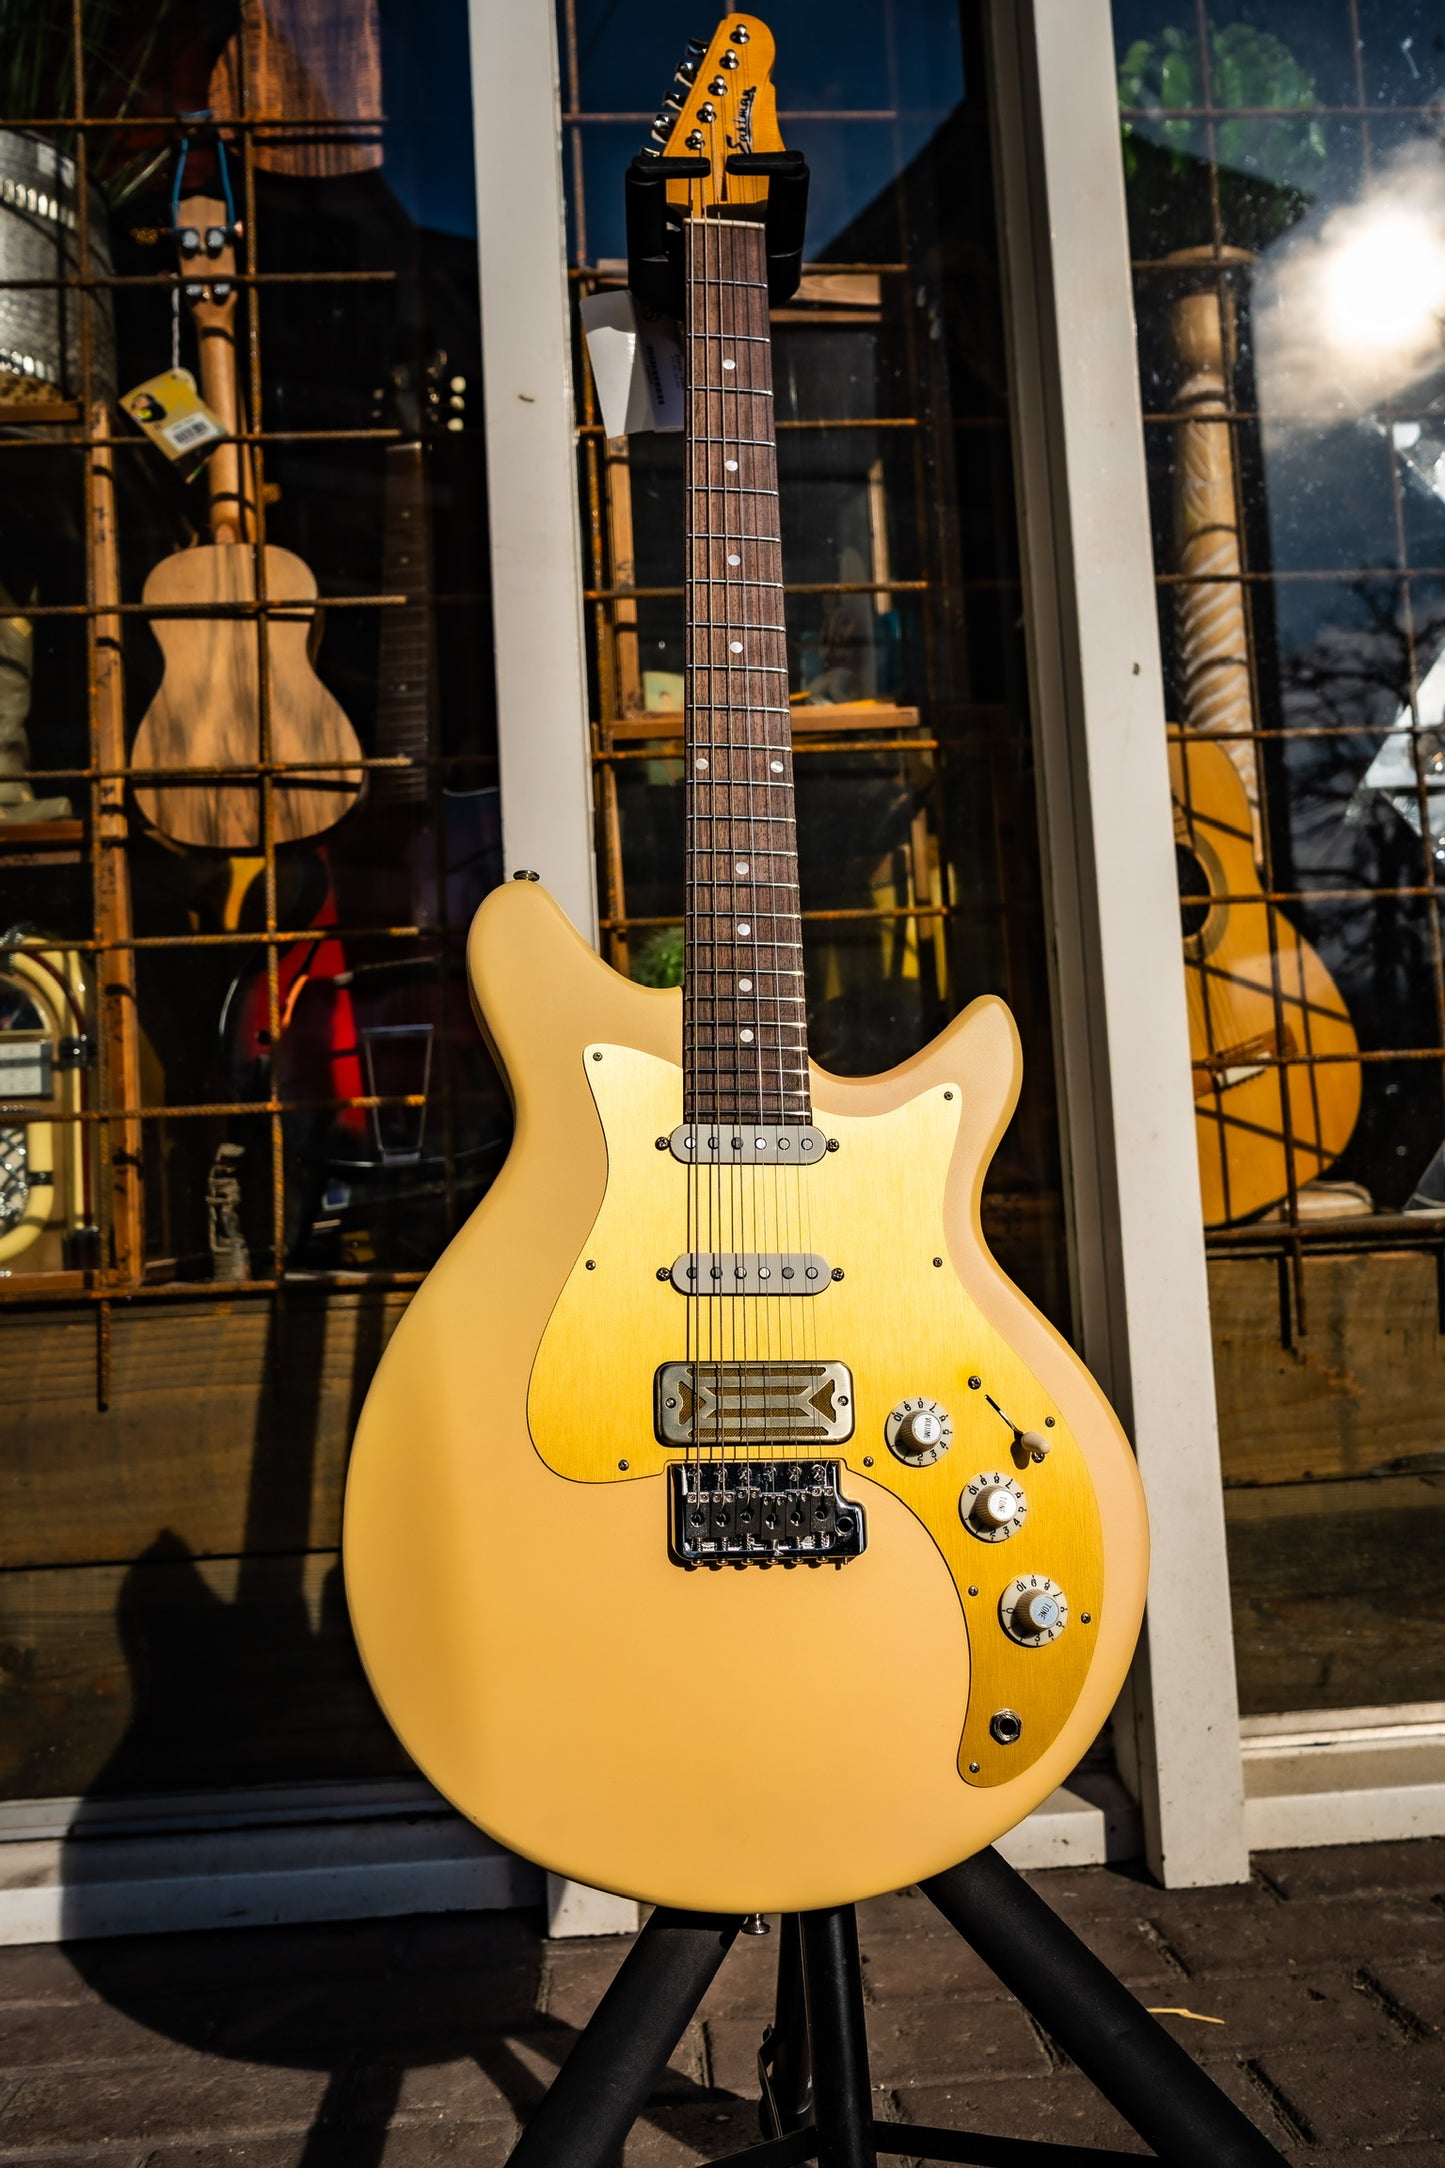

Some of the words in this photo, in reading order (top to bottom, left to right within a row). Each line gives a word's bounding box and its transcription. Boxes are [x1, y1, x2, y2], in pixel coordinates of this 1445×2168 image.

[727, 86, 756, 154] Eastman
[917, 1400, 924, 1408] 8
[893, 1412, 904, 1422] 10
[924, 1417, 932, 1440] VOLUME
[917, 1453, 924, 1462] 2
[930, 1449, 937, 1458] 3
[994, 1476, 1000, 1484] 8
[968, 1486, 980, 1495] 10
[998, 1496, 1008, 1514] TONE
[1013, 1518, 1020, 1526] 4
[989, 1528, 996, 1537] 2
[1003, 1526, 1010, 1534] 3
[1016, 1582, 1027, 1592] 10
[1044, 1582, 1050, 1590] 8
[1038, 1602, 1052, 1621] TONE
[1034, 1633, 1041, 1642] 3
[1048, 1630, 1054, 1638] 4
